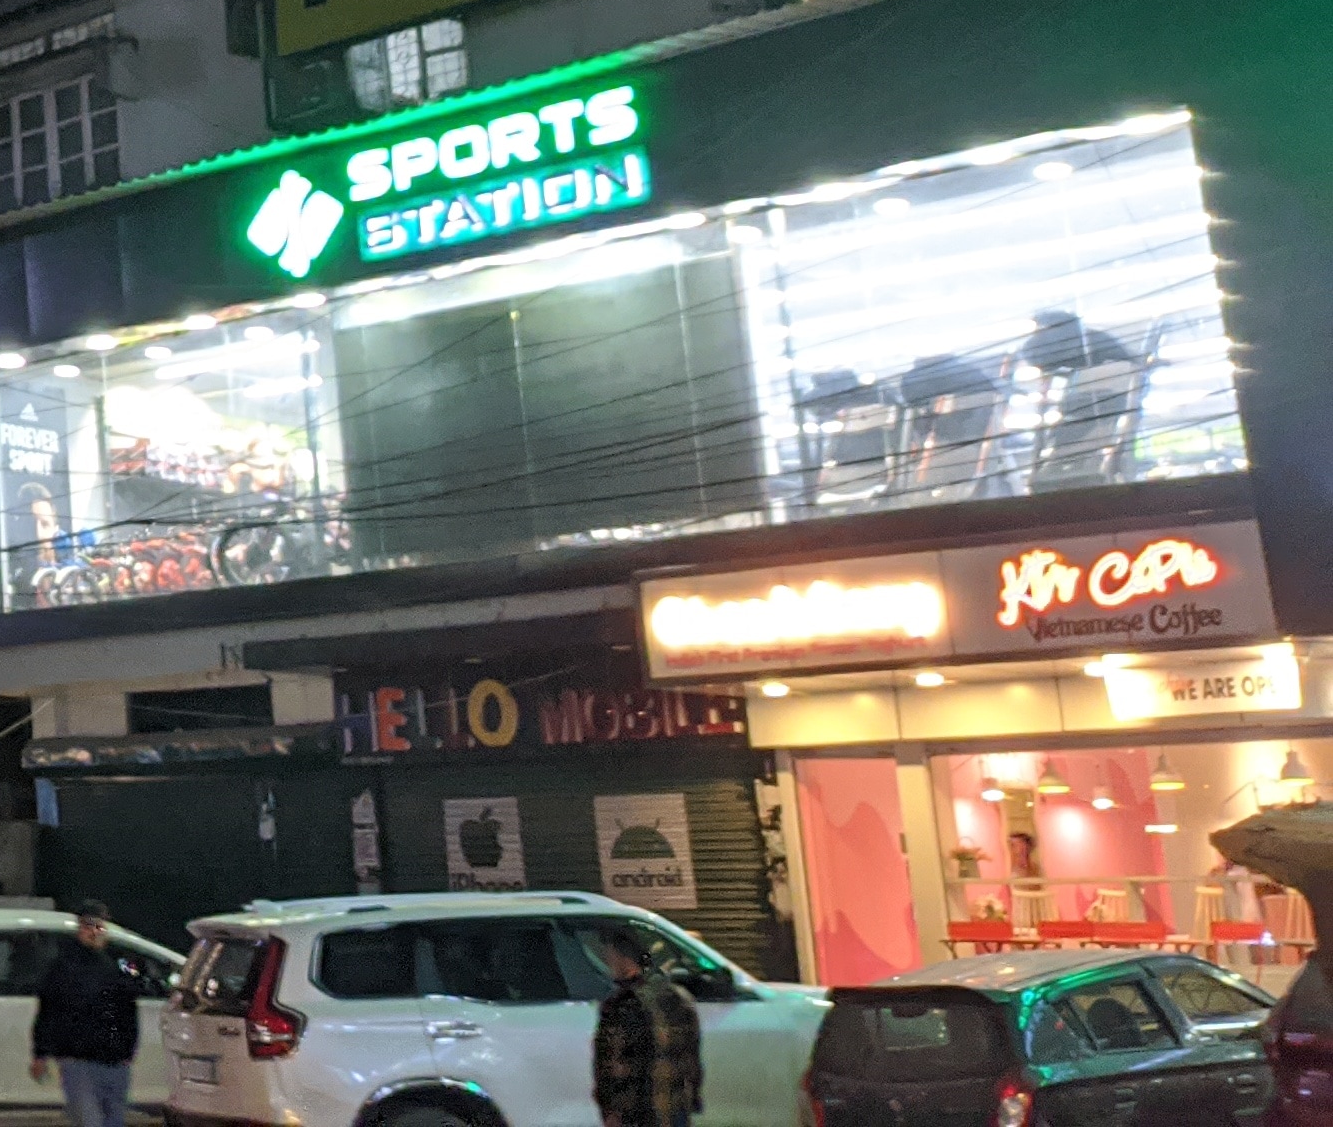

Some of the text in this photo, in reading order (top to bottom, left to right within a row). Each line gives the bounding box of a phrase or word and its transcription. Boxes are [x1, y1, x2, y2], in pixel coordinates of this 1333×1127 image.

[347, 86, 639, 202] SPORTS
[365, 154, 645, 255] STATION
[0, 422, 60, 454] FOREVER
[9, 448, 53, 476] SPORT
[1027, 603, 1223, 642] Vietnamese Coffee
[1203, 676, 1237, 699] ARE
[340, 677, 519, 753] HELLO
[612, 866, 684, 888] android
